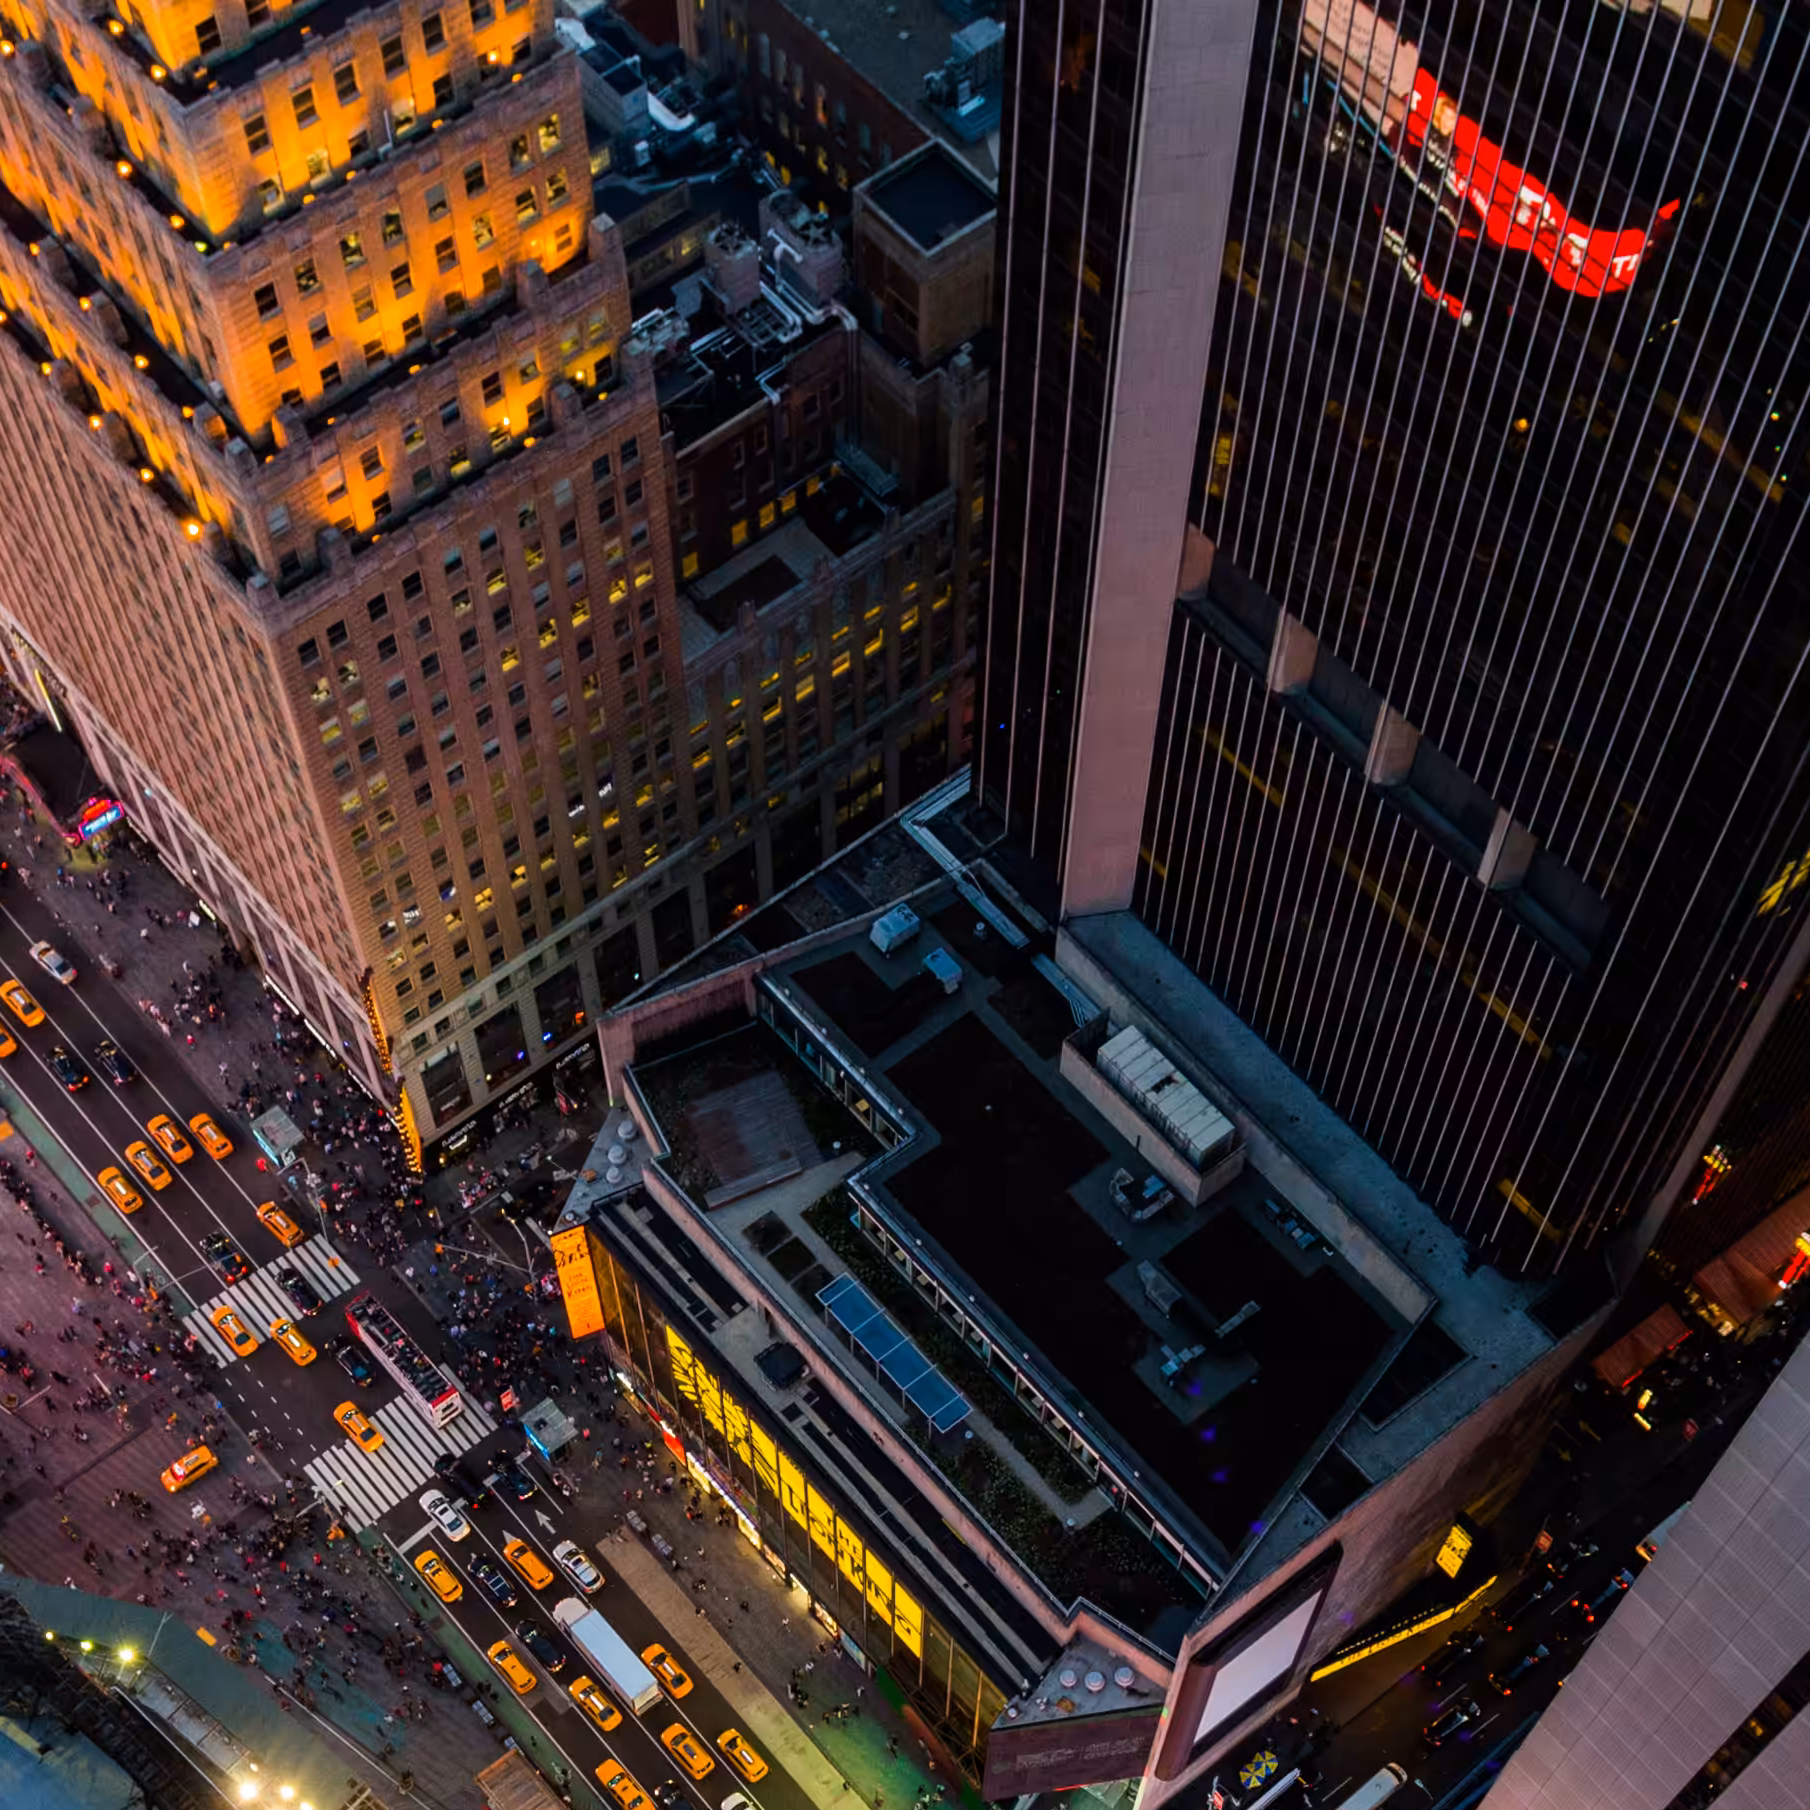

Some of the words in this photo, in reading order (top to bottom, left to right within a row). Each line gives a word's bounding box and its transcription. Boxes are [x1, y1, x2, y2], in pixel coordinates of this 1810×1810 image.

[789, 1486, 846, 1561] LION
[851, 1554, 913, 1637] KING
[824, 1510, 860, 1554] THE
